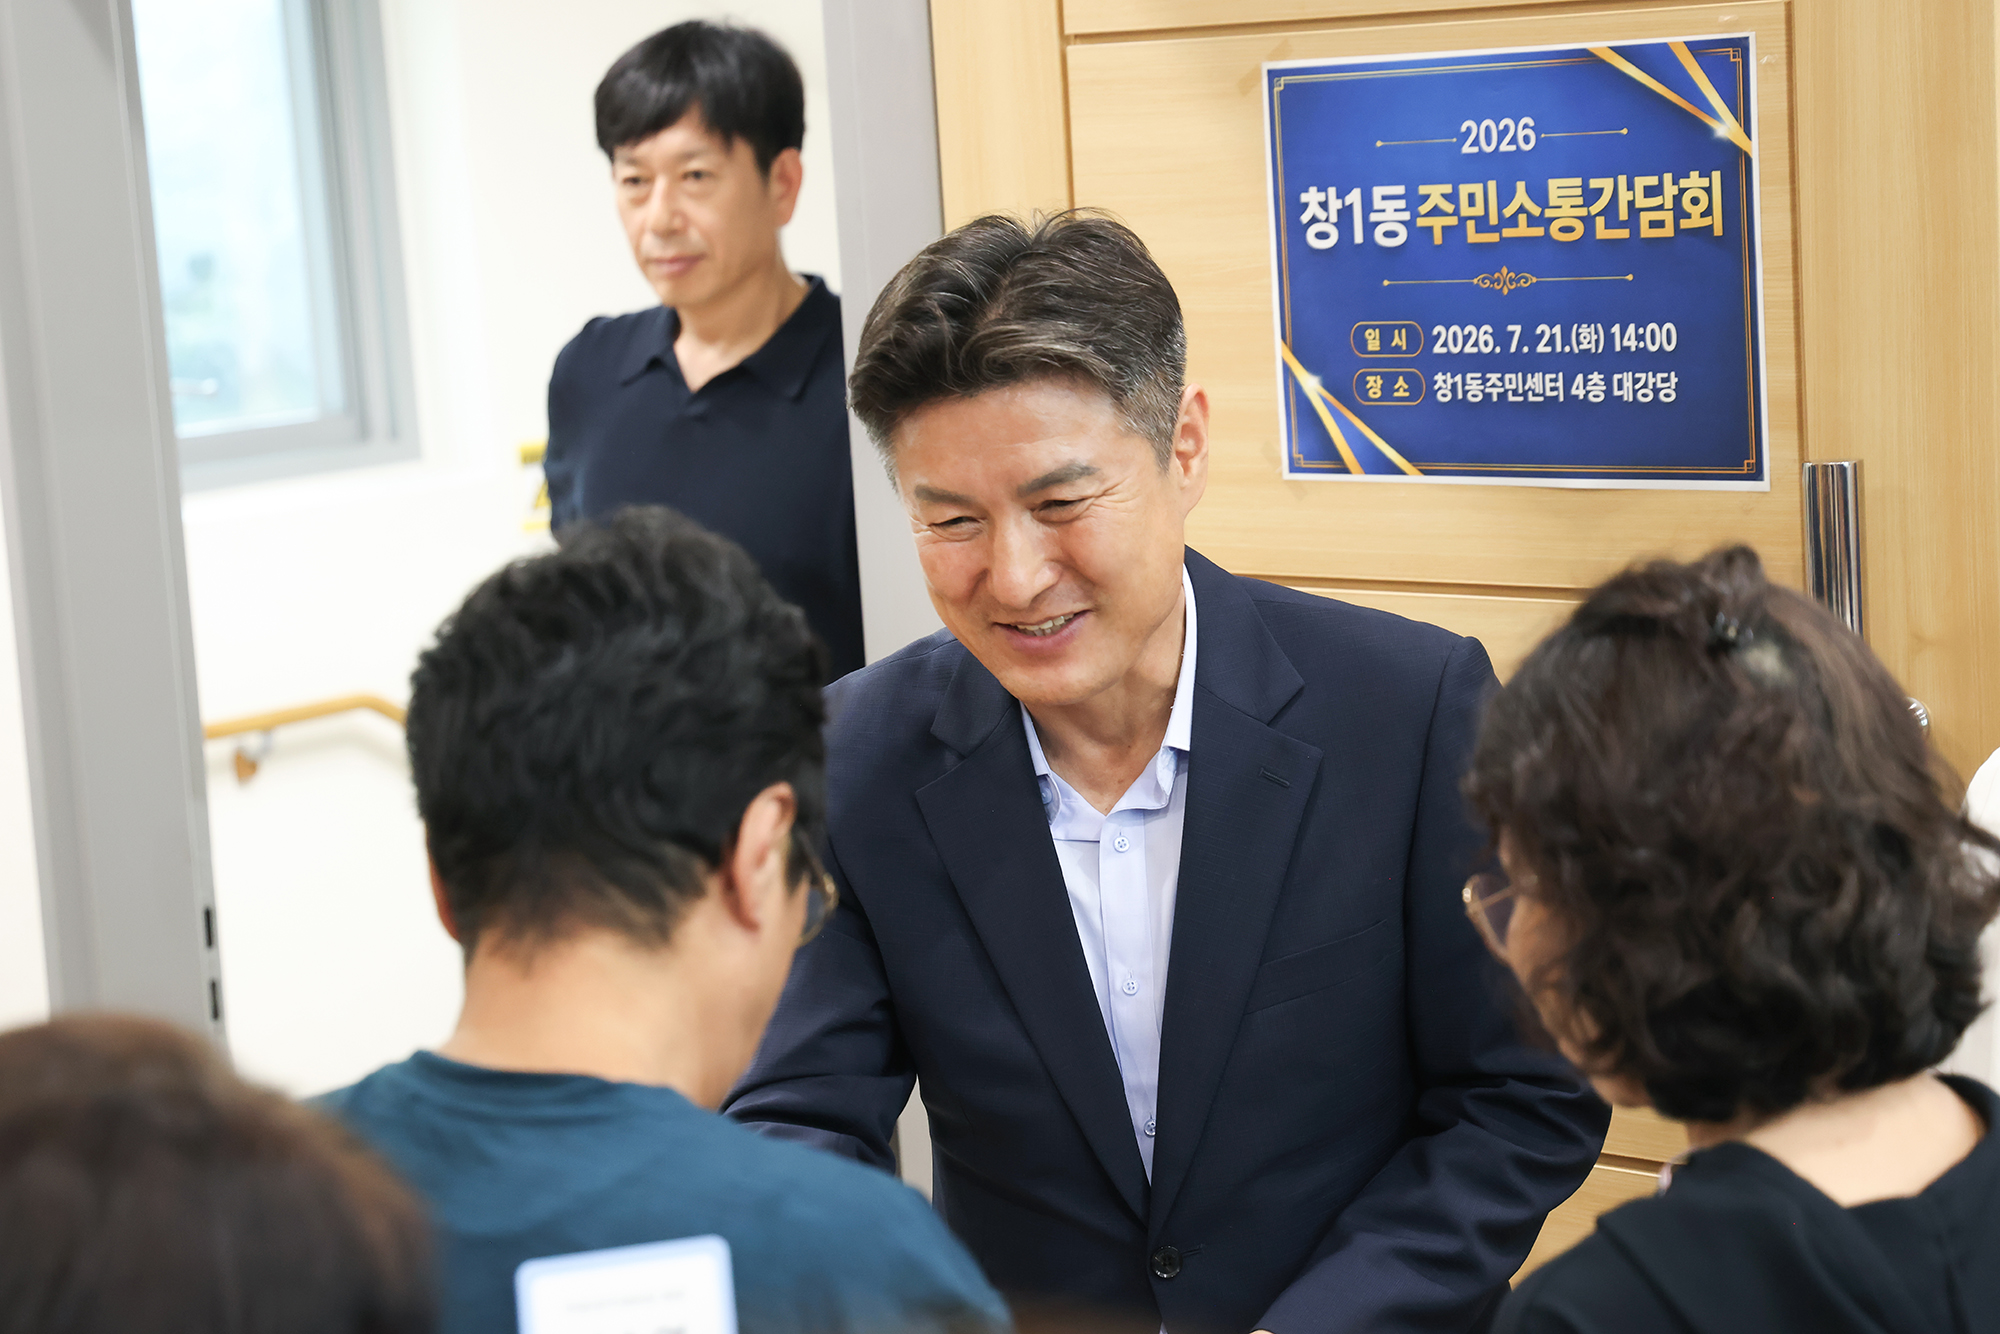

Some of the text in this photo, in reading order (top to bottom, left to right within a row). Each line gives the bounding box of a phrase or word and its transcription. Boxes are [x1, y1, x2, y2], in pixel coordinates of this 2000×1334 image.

[1461, 117, 1537, 153] 2026
[1300, 171, 1724, 249] 창1동 주민소통간담회
[1432, 325, 1501, 354] 2026.
[1507, 325, 1529, 354] 7.
[1536, 323, 1605, 354] 21.(화)
[1611, 323, 1678, 352] 14:00
[1434, 372, 1564, 403] 창1동주민센터
[1571, 372, 1607, 403] 4층
[1613, 372, 1679, 403] 대강당
